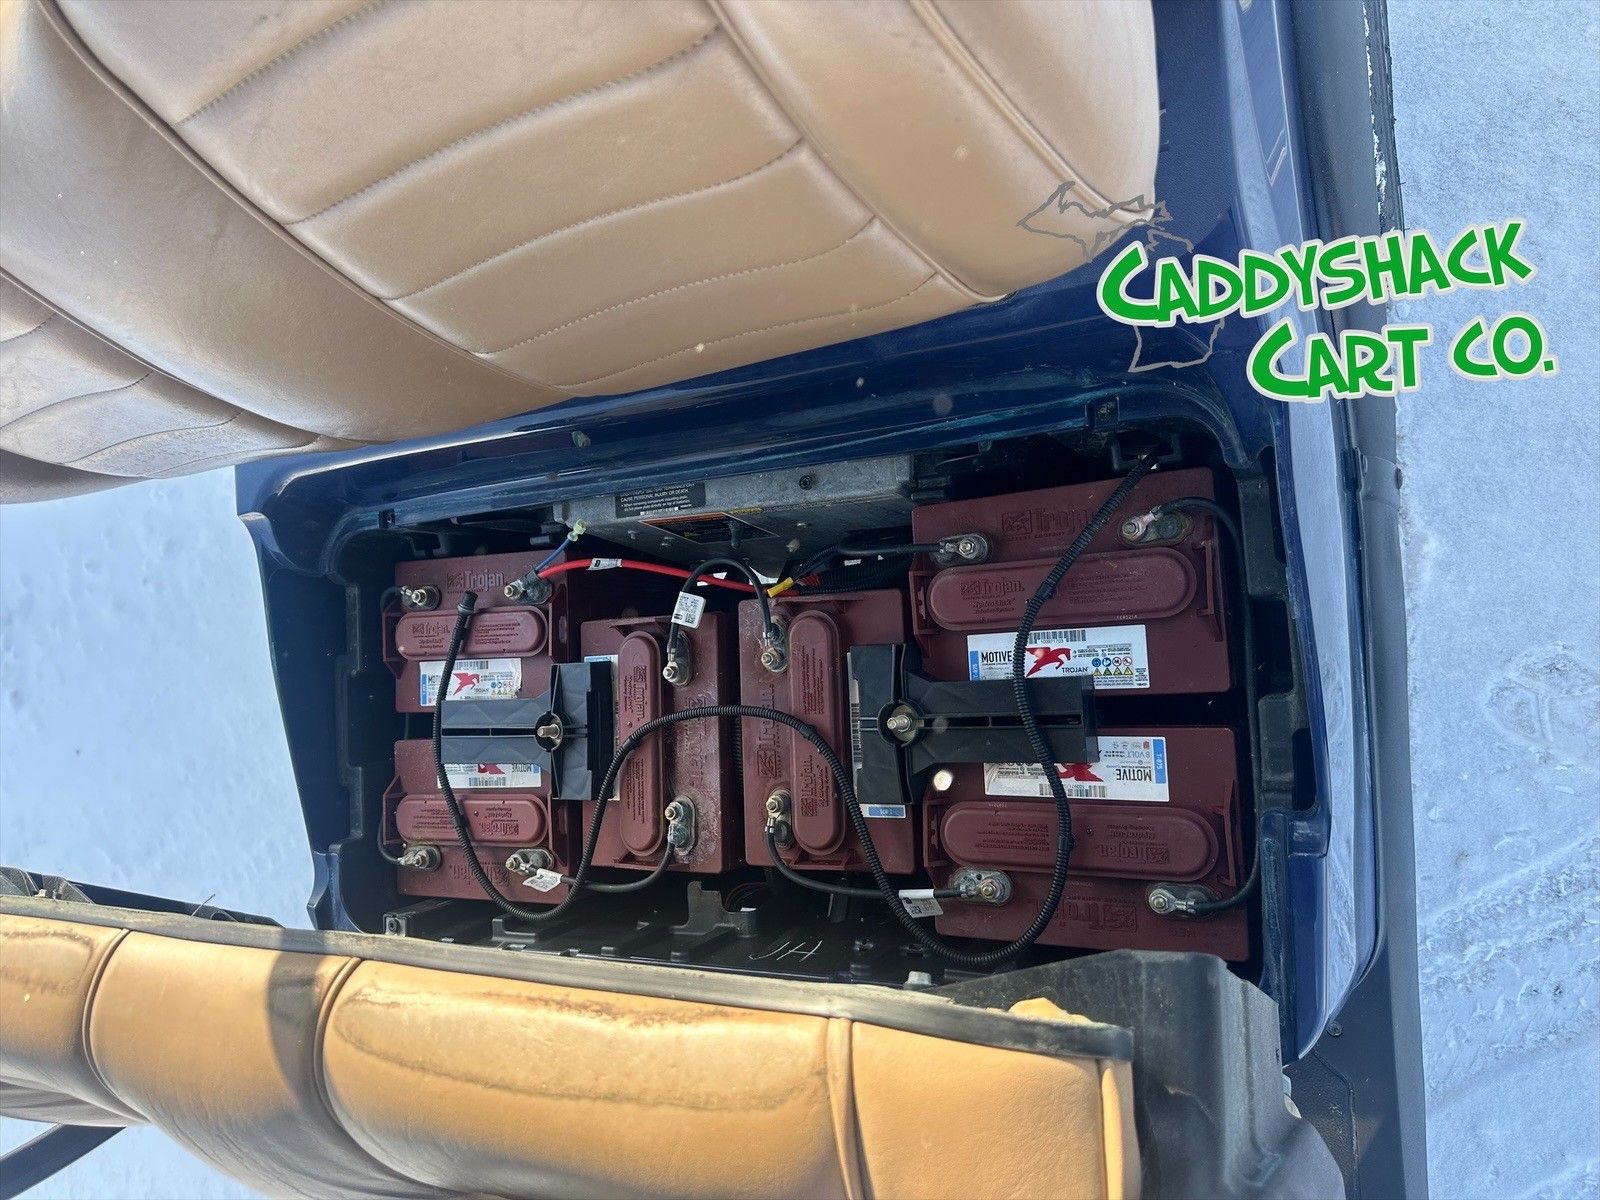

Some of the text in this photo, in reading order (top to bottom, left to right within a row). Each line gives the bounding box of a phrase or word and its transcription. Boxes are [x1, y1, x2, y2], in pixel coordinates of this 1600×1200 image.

[980, 650, 1012, 663] MOTIVE
[1062, 666, 1087, 674] TROJAN
[1115, 768, 1152, 782] MOTIVE
